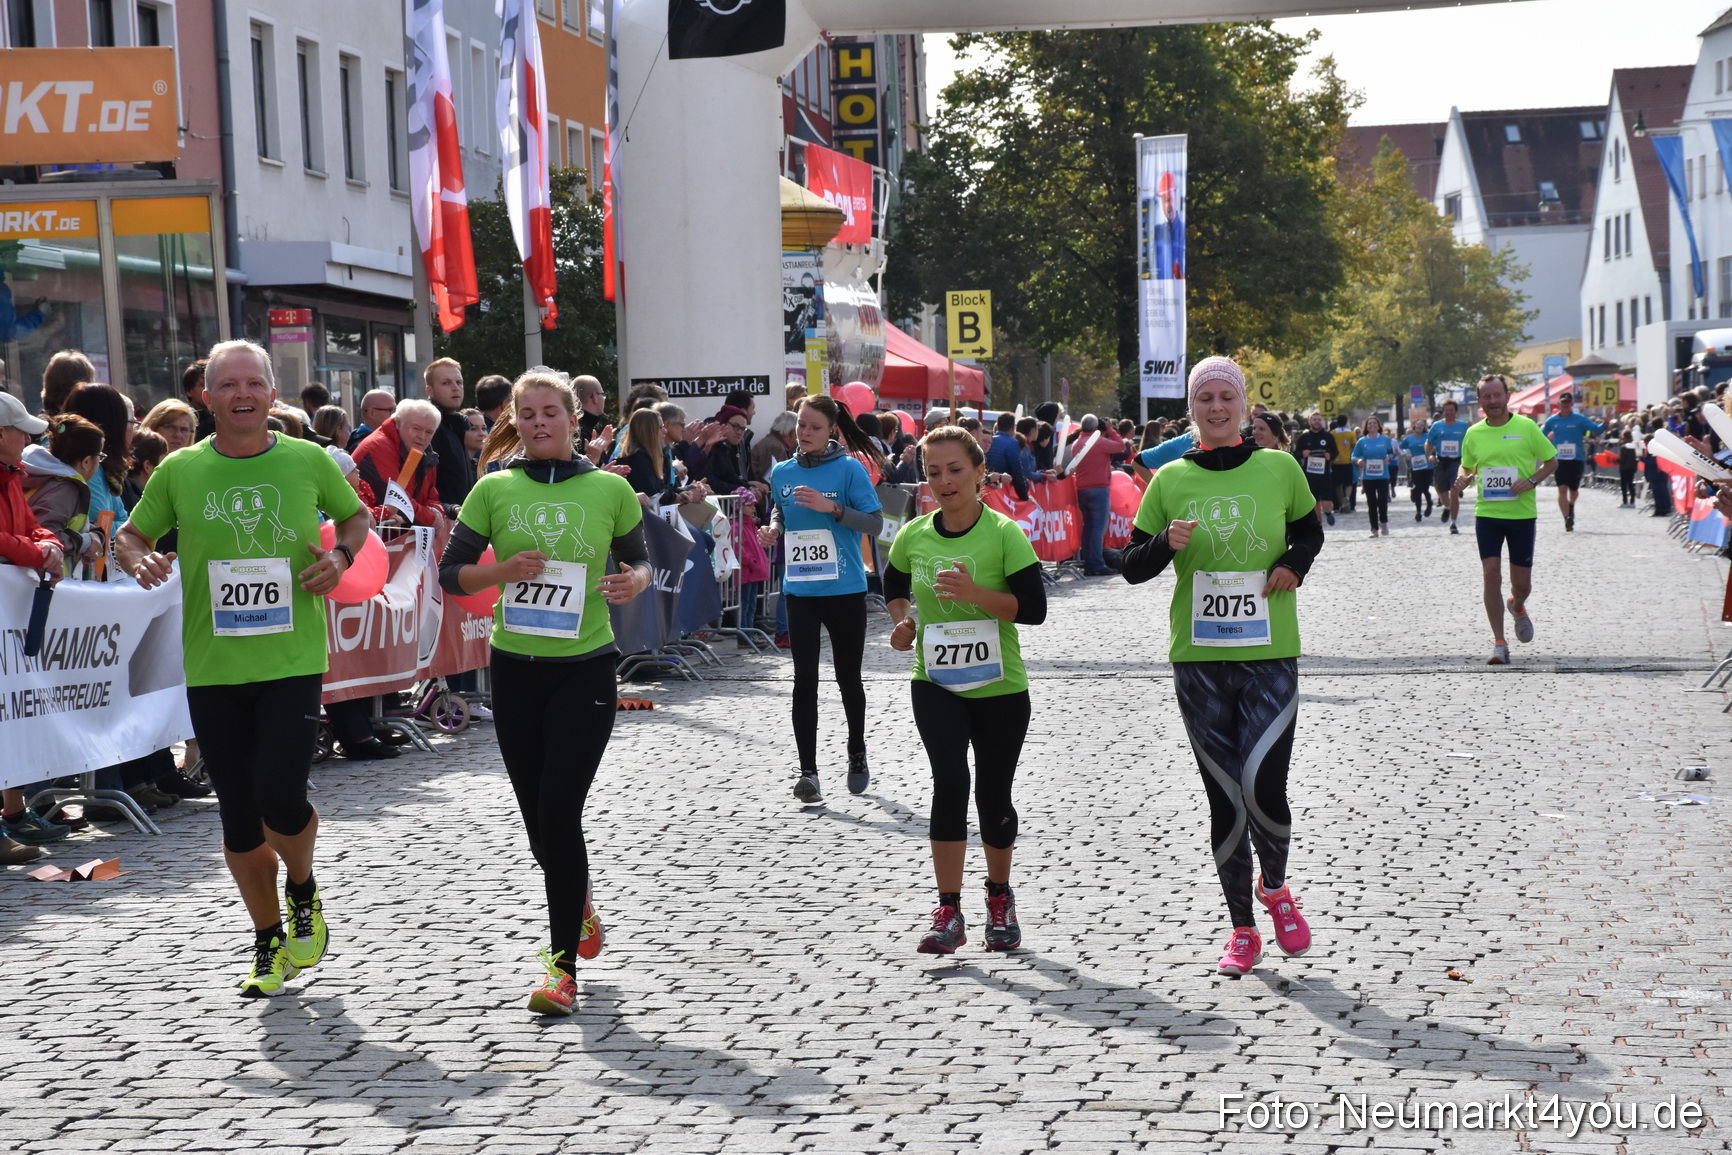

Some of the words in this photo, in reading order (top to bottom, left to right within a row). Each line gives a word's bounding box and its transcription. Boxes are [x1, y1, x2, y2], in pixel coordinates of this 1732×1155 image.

[0, 81, 152, 135] KT.DE
[951, 294, 986, 306] Block
[958, 311, 981, 344] B
[1256, 371, 1276, 379] Block
[1260, 381, 1273, 400] C
[1605, 387, 1616, 400] D
[1324, 399, 1334, 412] D
[1487, 477, 1512, 488] 2304
[792, 544, 829, 562] 2138
[798, 565, 823, 573] Christina
[220, 582, 280, 607] 2076
[514, 581, 573, 608] 2777
[1202, 593, 1257, 618] 2075
[234, 612, 268, 623] Michael
[1216, 625, 1244, 634] Teresa
[934, 641, 990, 666] 2770
